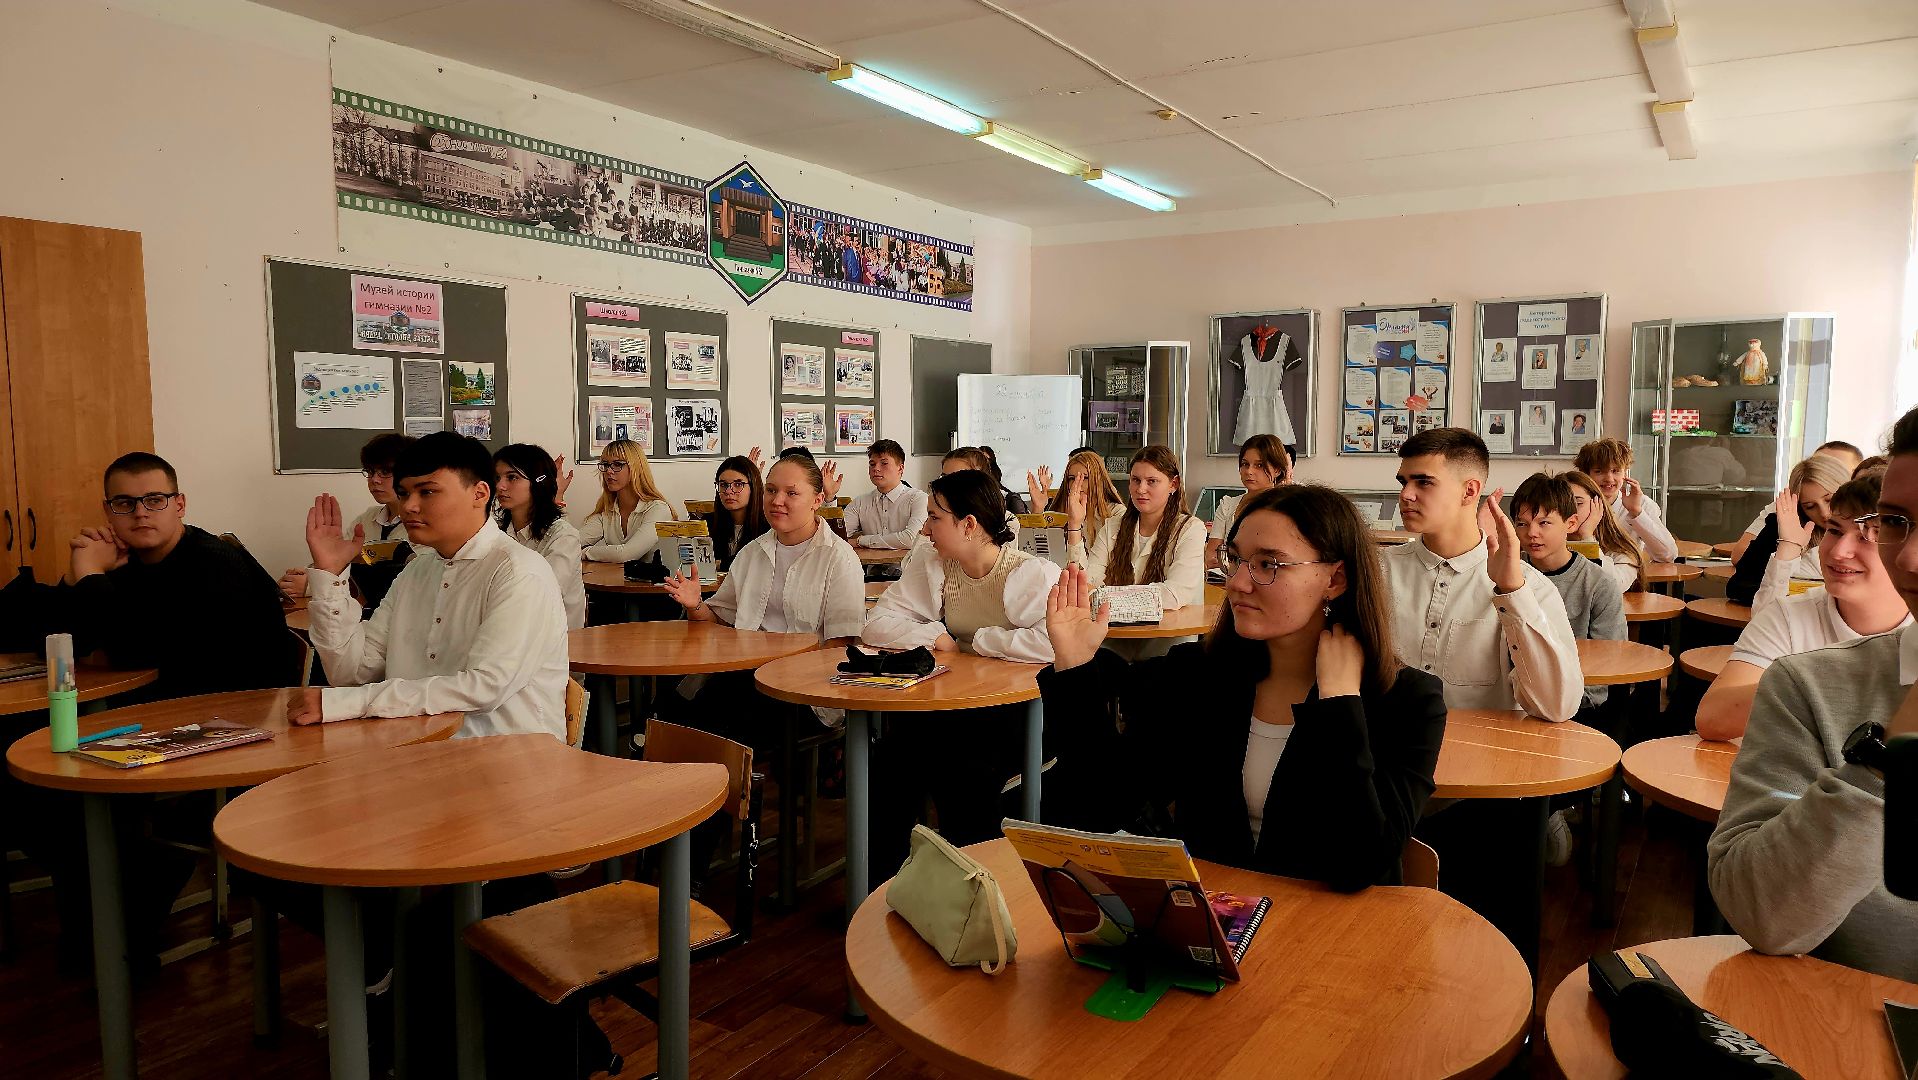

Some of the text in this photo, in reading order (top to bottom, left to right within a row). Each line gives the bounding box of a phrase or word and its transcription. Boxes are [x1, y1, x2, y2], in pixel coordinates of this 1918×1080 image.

[360, 282, 435, 300] Музей истории
[364, 301, 432, 315] гимназии №2
